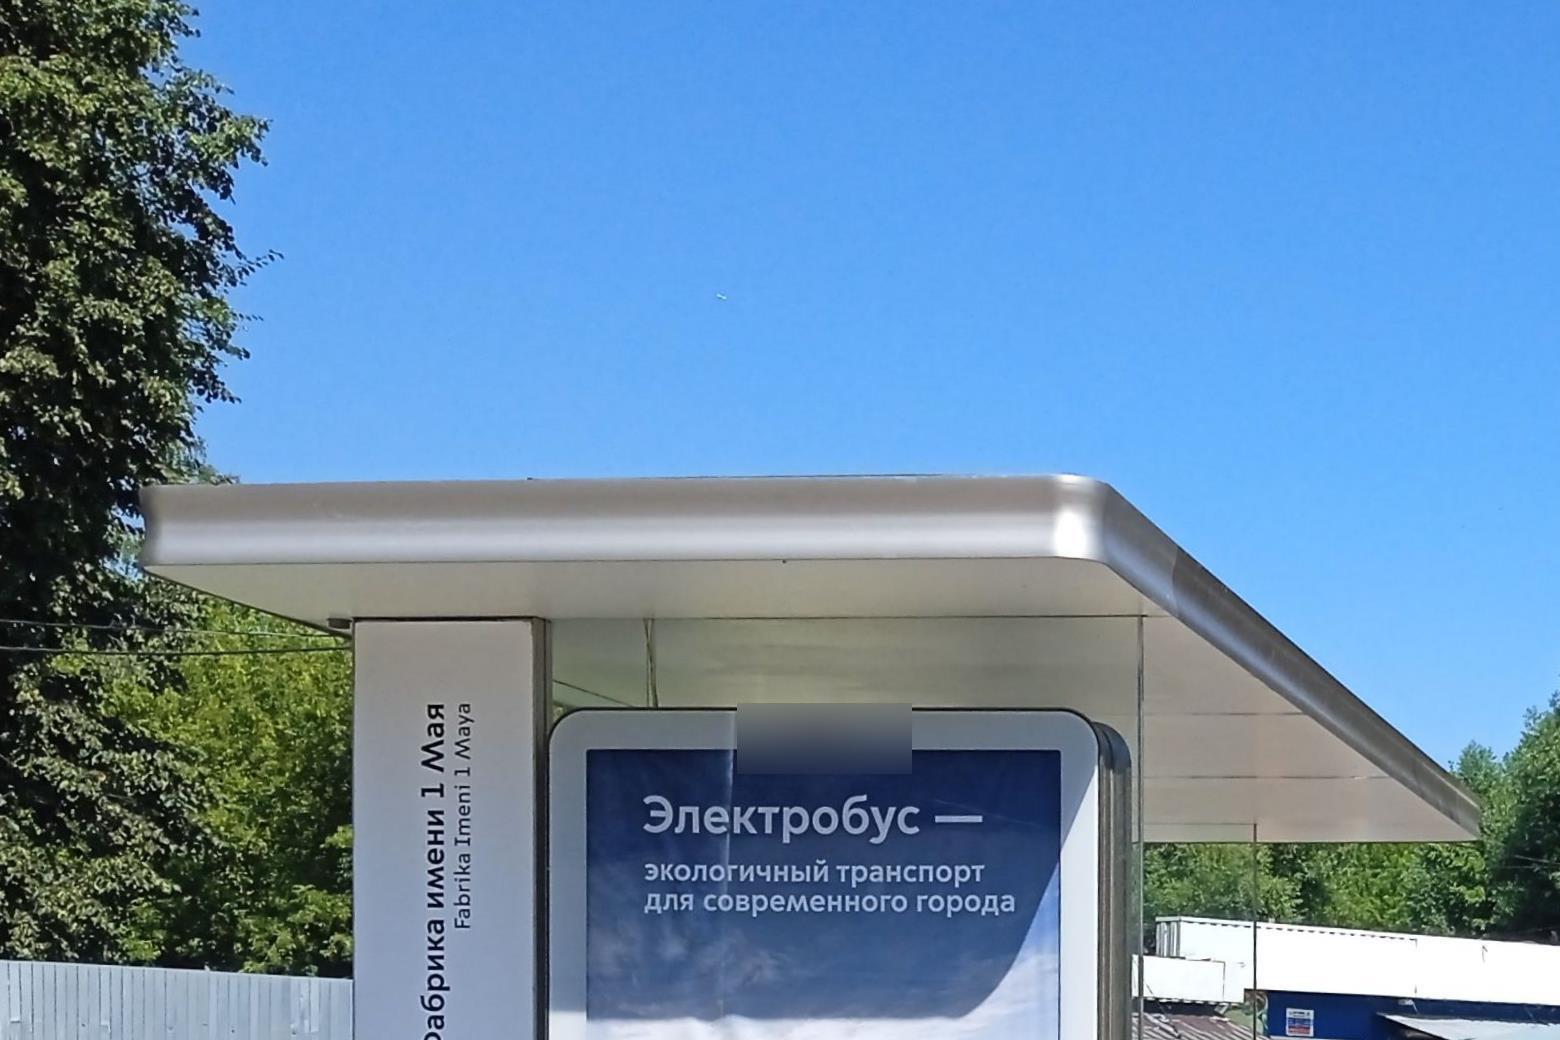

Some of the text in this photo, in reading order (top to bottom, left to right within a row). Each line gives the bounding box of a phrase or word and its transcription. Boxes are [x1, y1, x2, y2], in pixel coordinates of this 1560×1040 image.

[421, 703, 445, 773] Мая
[421, 782, 445, 798] 1
[453, 703, 475, 930] Fabrika Imeni 1 Maya
[643, 794, 921, 844] Электробус
[427, 809, 445, 909] имени
[644, 859, 985, 888] экологичный транспорт
[644, 892, 1016, 918] для современного города
